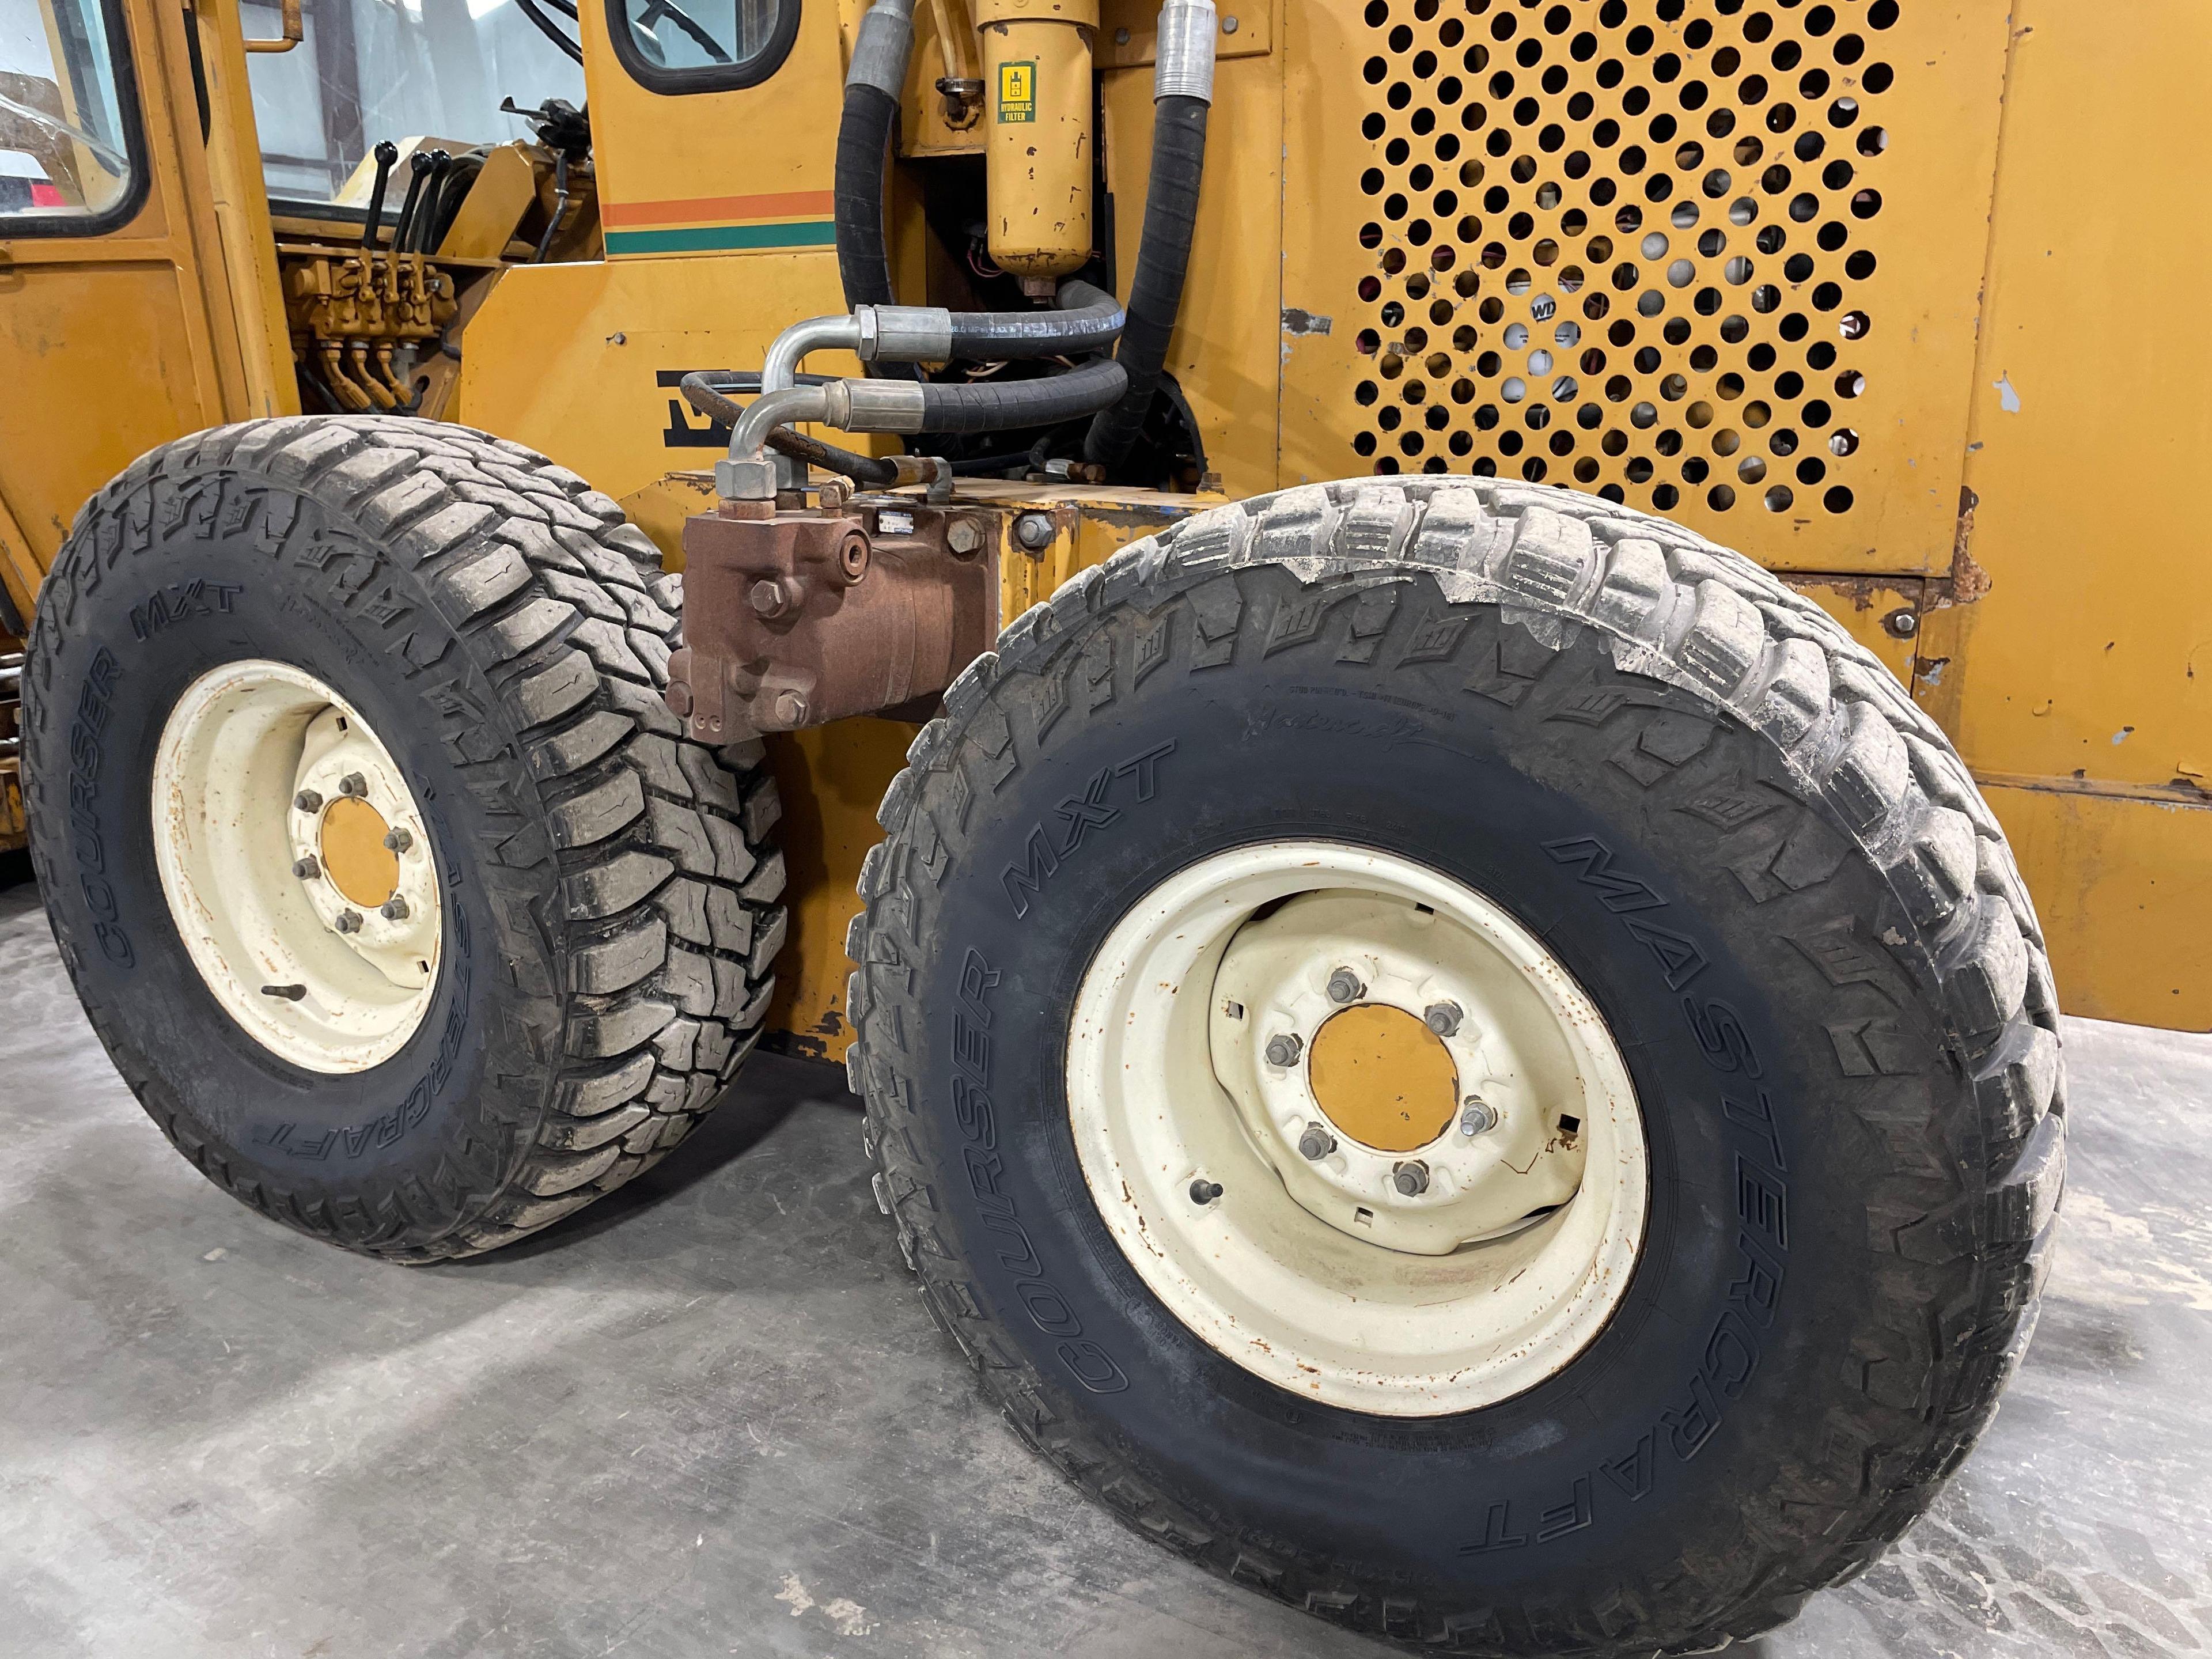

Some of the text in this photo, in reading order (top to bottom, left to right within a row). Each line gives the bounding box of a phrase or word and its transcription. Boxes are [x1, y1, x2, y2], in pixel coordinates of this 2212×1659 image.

[1001, 103, 1032, 112] HYDRAULIC
[1005, 112, 1026, 122] FILTER
[65, 578, 244, 969] COURSER MXT
[252, 770, 471, 1161] MASTERCRAFT
[949, 737, 1177, 1394] COURSER MXT
[1459, 832, 1790, 1556] MASTERCRAFT
